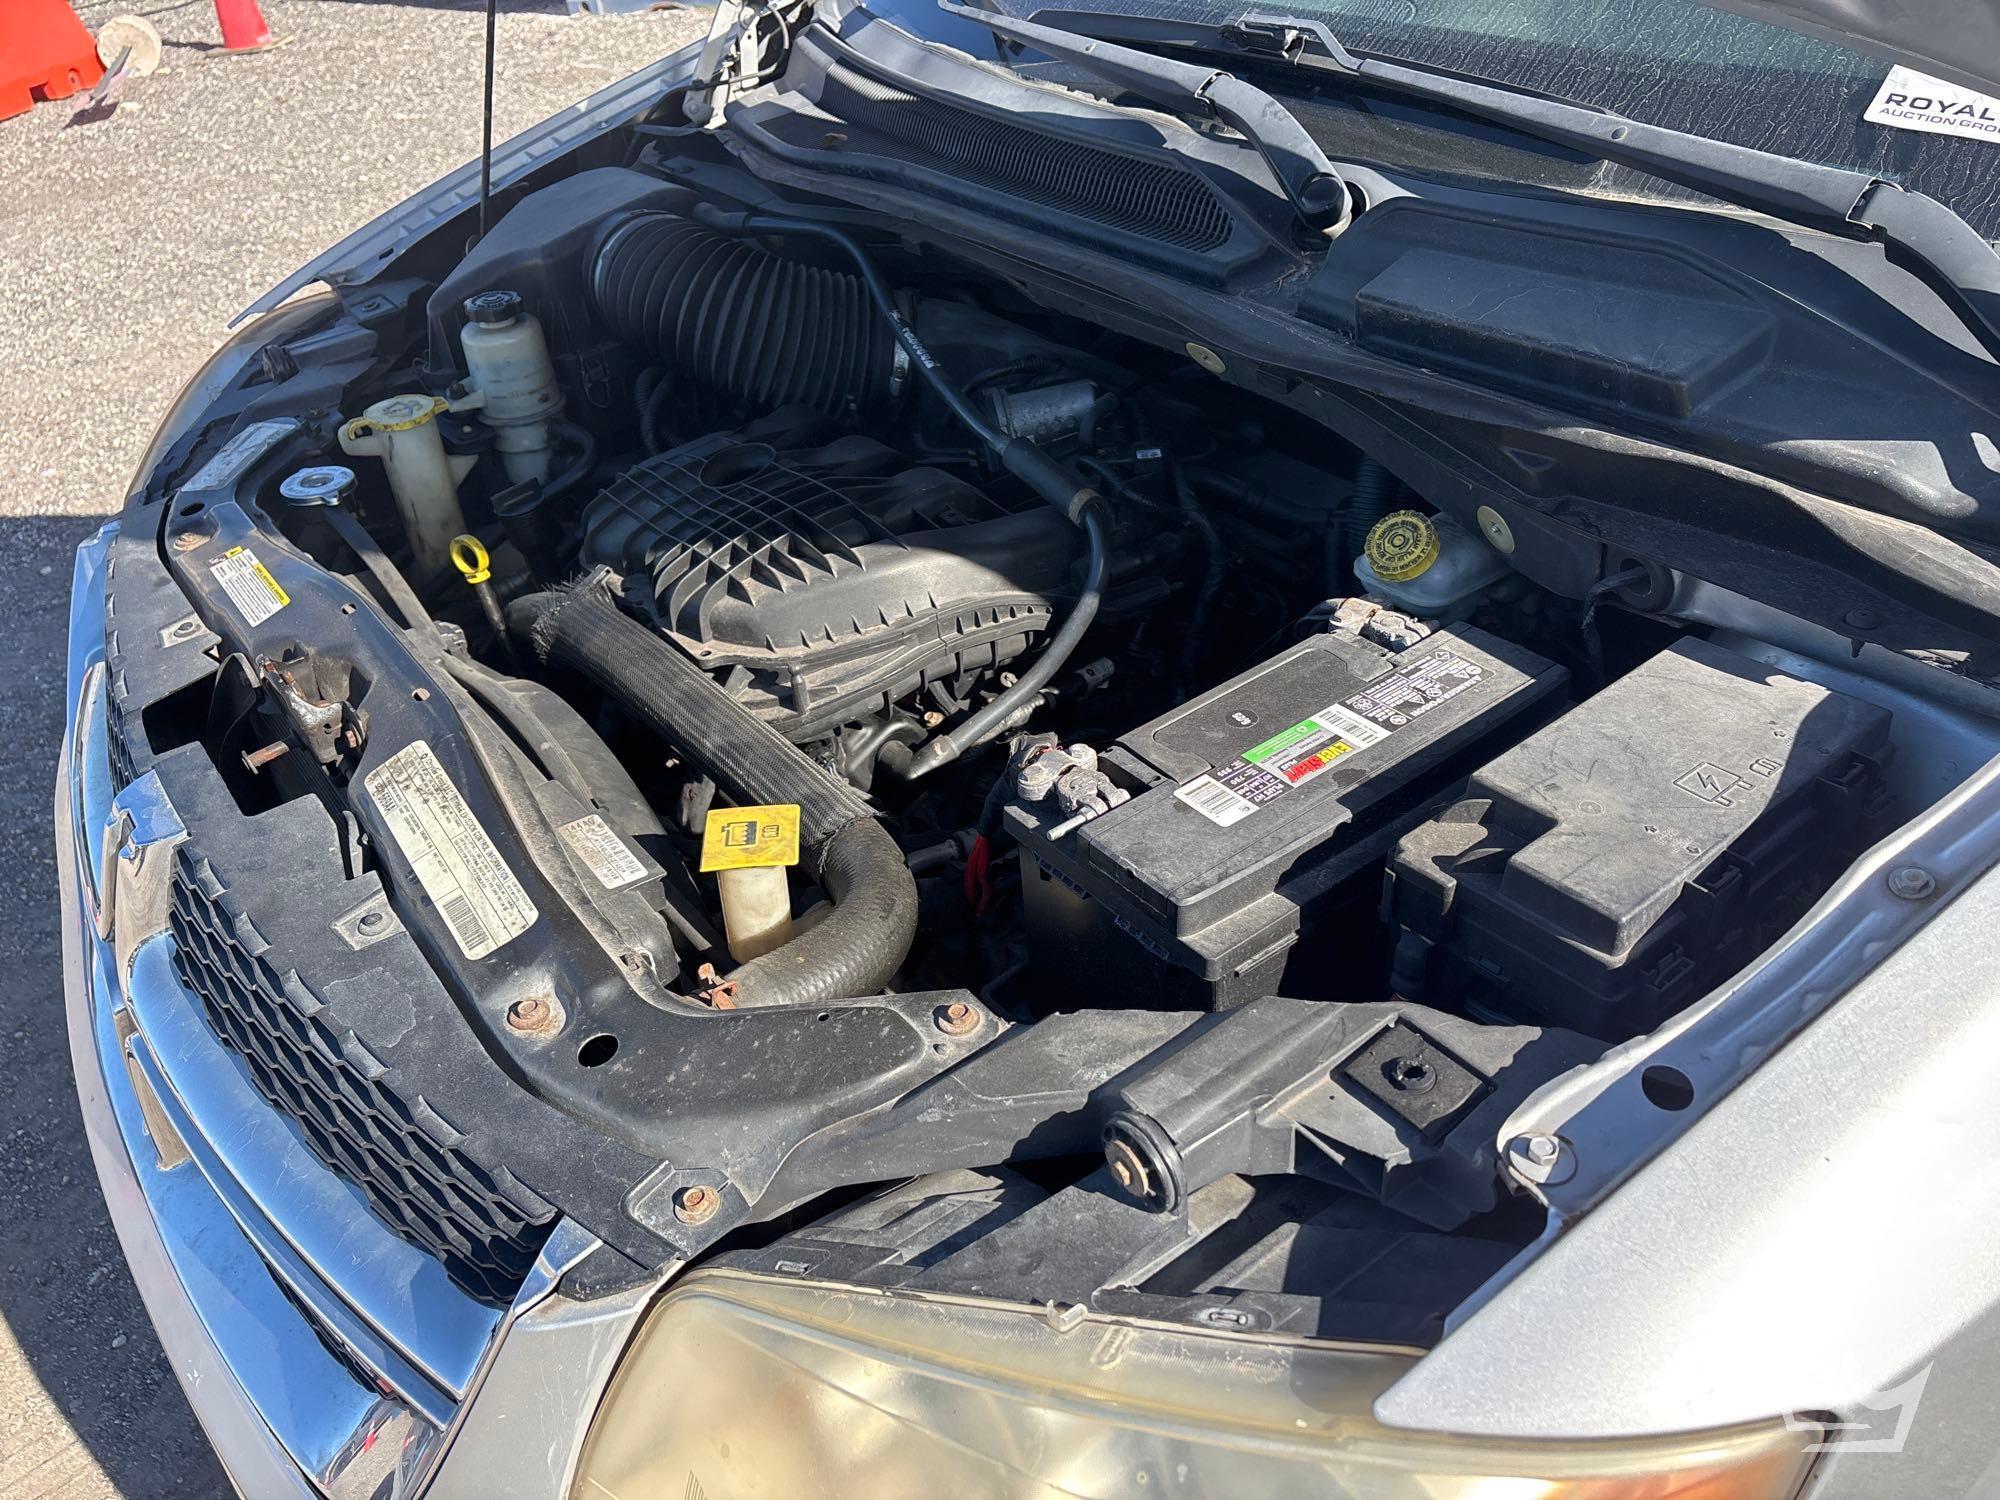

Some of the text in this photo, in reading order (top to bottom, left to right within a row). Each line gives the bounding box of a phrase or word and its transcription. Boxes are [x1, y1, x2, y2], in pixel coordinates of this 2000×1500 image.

[1880, 107, 1957, 126] AUCTION
[1884, 93, 1995, 121] ROYAL
[1279, 758, 1297, 770] PLUS
[1281, 739, 1355, 784] EverStart
[1262, 782, 1284, 796] PLUS
[472, 830, 490, 852] CONTROL
[486, 849, 510, 881] INFORMATION
